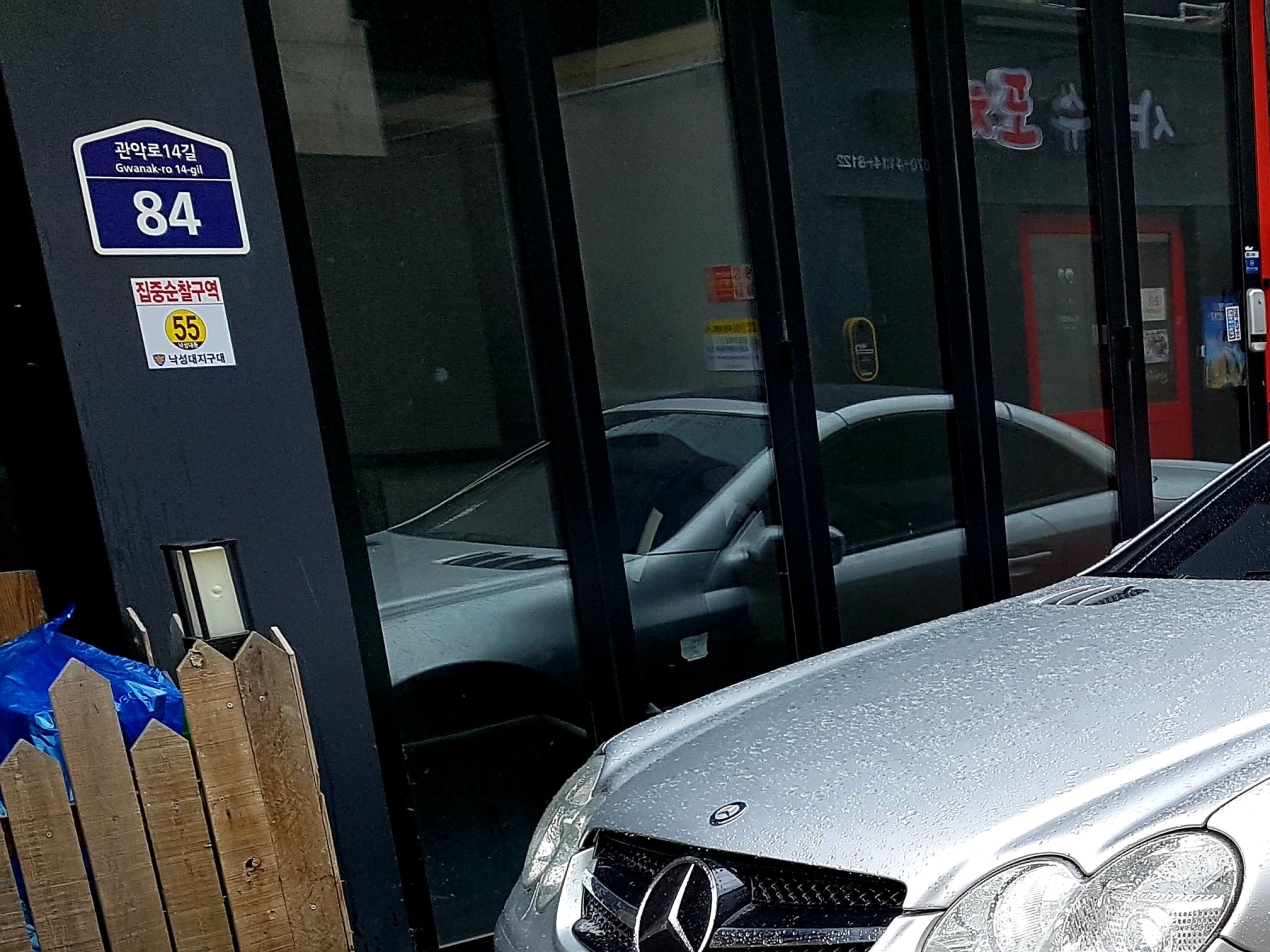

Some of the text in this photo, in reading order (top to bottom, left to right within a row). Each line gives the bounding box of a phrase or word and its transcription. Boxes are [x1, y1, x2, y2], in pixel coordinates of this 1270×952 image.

[114, 141, 198, 162] 관악로14길
[115, 163, 203, 177] Gwanak-ro 14-gil
[133, 190, 202, 236] 84
[135, 280, 220, 303] 집중순찰구역
[172, 315, 200, 341] 55
[168, 353, 226, 365] 낙성대지구대
